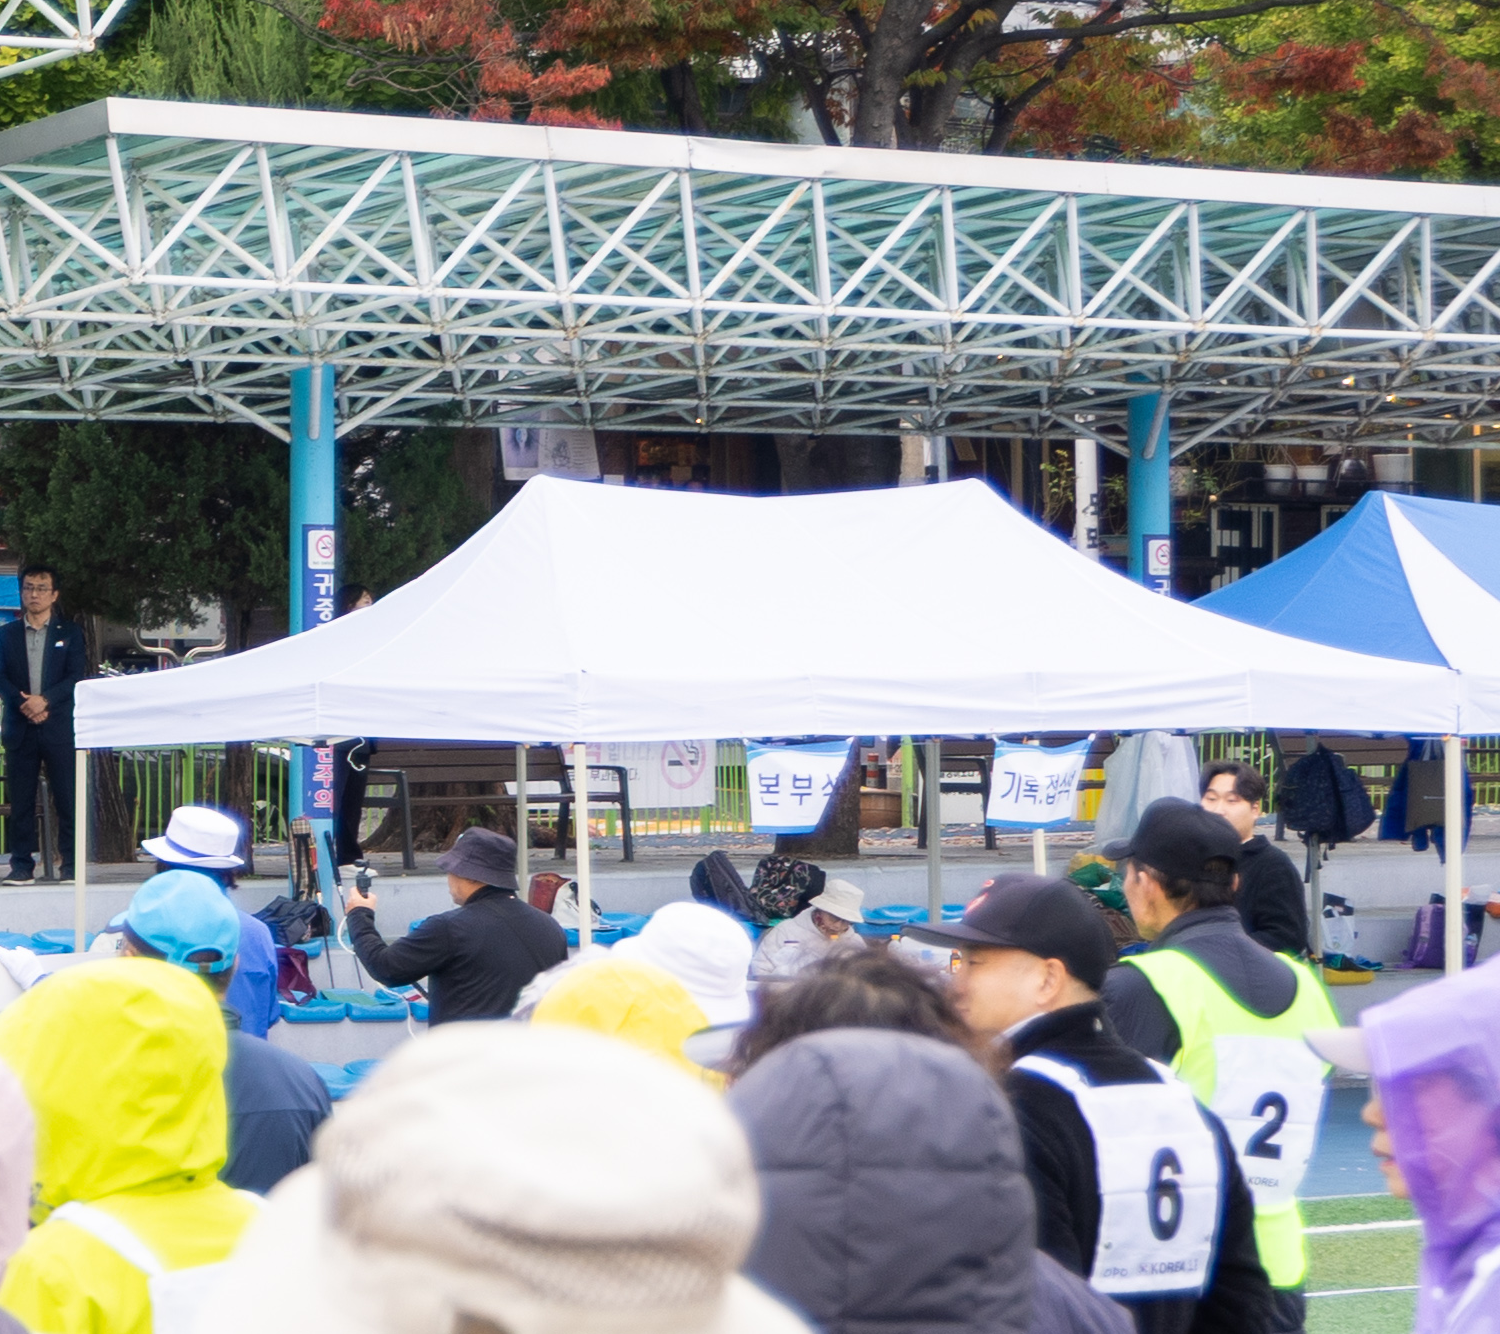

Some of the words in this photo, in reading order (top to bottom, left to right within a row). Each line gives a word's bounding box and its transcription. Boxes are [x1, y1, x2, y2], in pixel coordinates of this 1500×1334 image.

[313, 573, 334, 627] 귀중
[1243, 1090, 1289, 1161] 2
[1147, 1147, 1184, 1242] 6
[1247, 1176, 1280, 1187] KOREA
[1150, 1260, 1186, 1275] KOREA
